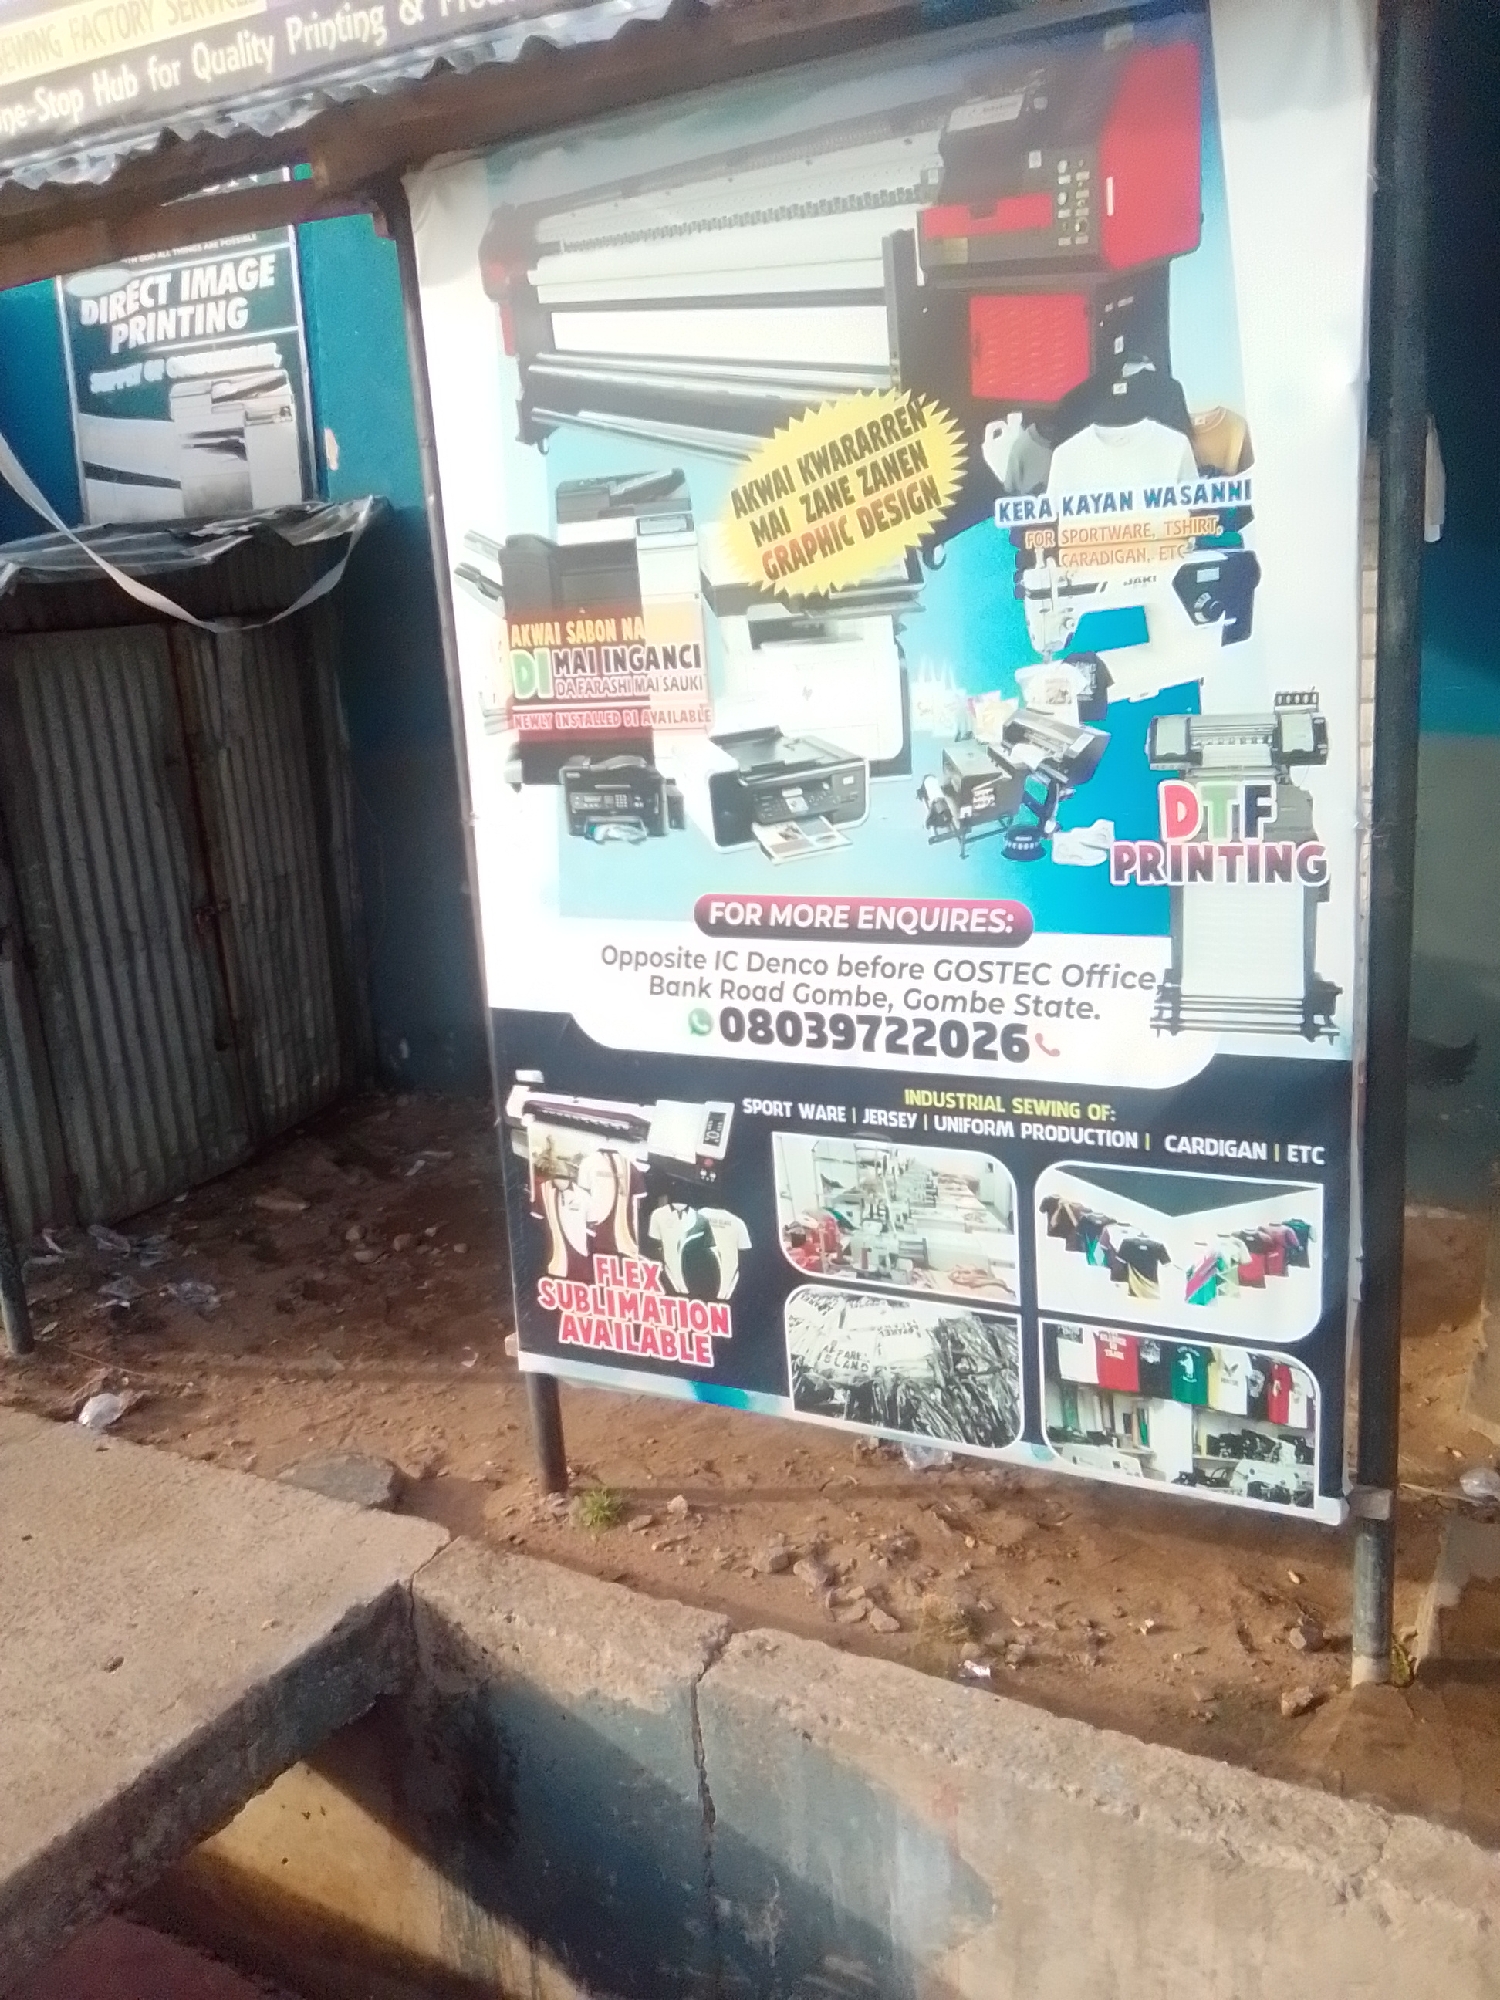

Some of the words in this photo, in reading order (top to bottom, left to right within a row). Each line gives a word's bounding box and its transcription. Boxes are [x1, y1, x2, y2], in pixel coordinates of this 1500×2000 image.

[69, 0, 157, 53] FACTORY
[0, 86, 85, 135] ne-Stop
[92, 64, 139, 106] Hub
[148, 54, 182, 92] for
[191, 29, 275, 83] Quality
[285, 2, 388, 55] Printing
[80, 273, 172, 326] DIRECT
[180, 255, 276, 302] IMAGE
[110, 297, 249, 355] PRINTING
[731, 465, 796, 519] AKWAI
[797, 397, 928, 486] KWARARREN
[750, 506, 792, 548] MAI
[799, 475, 856, 523] ZANE
[856, 439, 929, 498] ZANEN
[999, 497, 1053, 523] KERA
[1062, 490, 1134, 516] KAYAN
[1143, 478, 1252, 510] WASANNI
[762, 515, 855, 580] GRAPHIC
[856, 474, 942, 539] DESIGN
[1026, 530, 1055, 548] FOR
[1061, 523, 1156, 545] SPORTWARE,
[511, 622, 562, 648] AKWAI
[566, 617, 617, 645] SABON
[622, 617, 647, 640] NA
[511, 648, 554, 699] DI
[553, 648, 598, 675] MAI
[602, 643, 702, 673] INGANCI
[557, 679, 576, 696] DA
[634, 676, 660, 693] MAI
[663, 674, 704, 692] SAUKI
[513, 713, 553, 729] NEWLY
[556, 710, 620, 728] INSTALLED
[623, 709, 639, 727] DI
[641, 708, 712, 725] AVAILABLE
[1161, 781, 1275, 841] DTF
[1112, 842, 1329, 886] PRINTING
[708, 901, 764, 926] FOR
[769, 903, 851, 929] MORE
[857, 905, 1015, 935] ENQUIRES:
[601, 944, 708, 971] Opposite
[714, 951, 738, 972] IC
[747, 951, 829, 976] Denco
[838, 954, 925, 981] before
[934, 958, 1051, 986] GOSTEC
[650, 975, 712, 999] Bank
[720, 979, 785, 1002] Road
[793, 983, 894, 1012] Gombe,
[903, 988, 1006, 1015] Gombe
[1013, 993, 1101, 1020] State.
[719, 1006, 1030, 1063] 08039722026
[904, 1089, 1006, 1113] INDUSTRIAL
[1011, 1096, 1081, 1119] SEWING
[1087, 1102, 1117, 1121] OF:
[742, 1097, 793, 1118] SPORT
[798, 1102, 847, 1122] WARE
[862, 1108, 918, 1129] JERSEY
[933, 1114, 1015, 1138] UNIFORM
[1021, 1122, 1138, 1150] PRODUCTION
[1164, 1134, 1268, 1160] CARDIGAN
[1287, 1144, 1326, 1165] ETC
[594, 1255, 663, 1294] FLEX
[538, 1278, 731, 1337] SUBLIMATION
[560, 1313, 714, 1366] AVAILABLE
